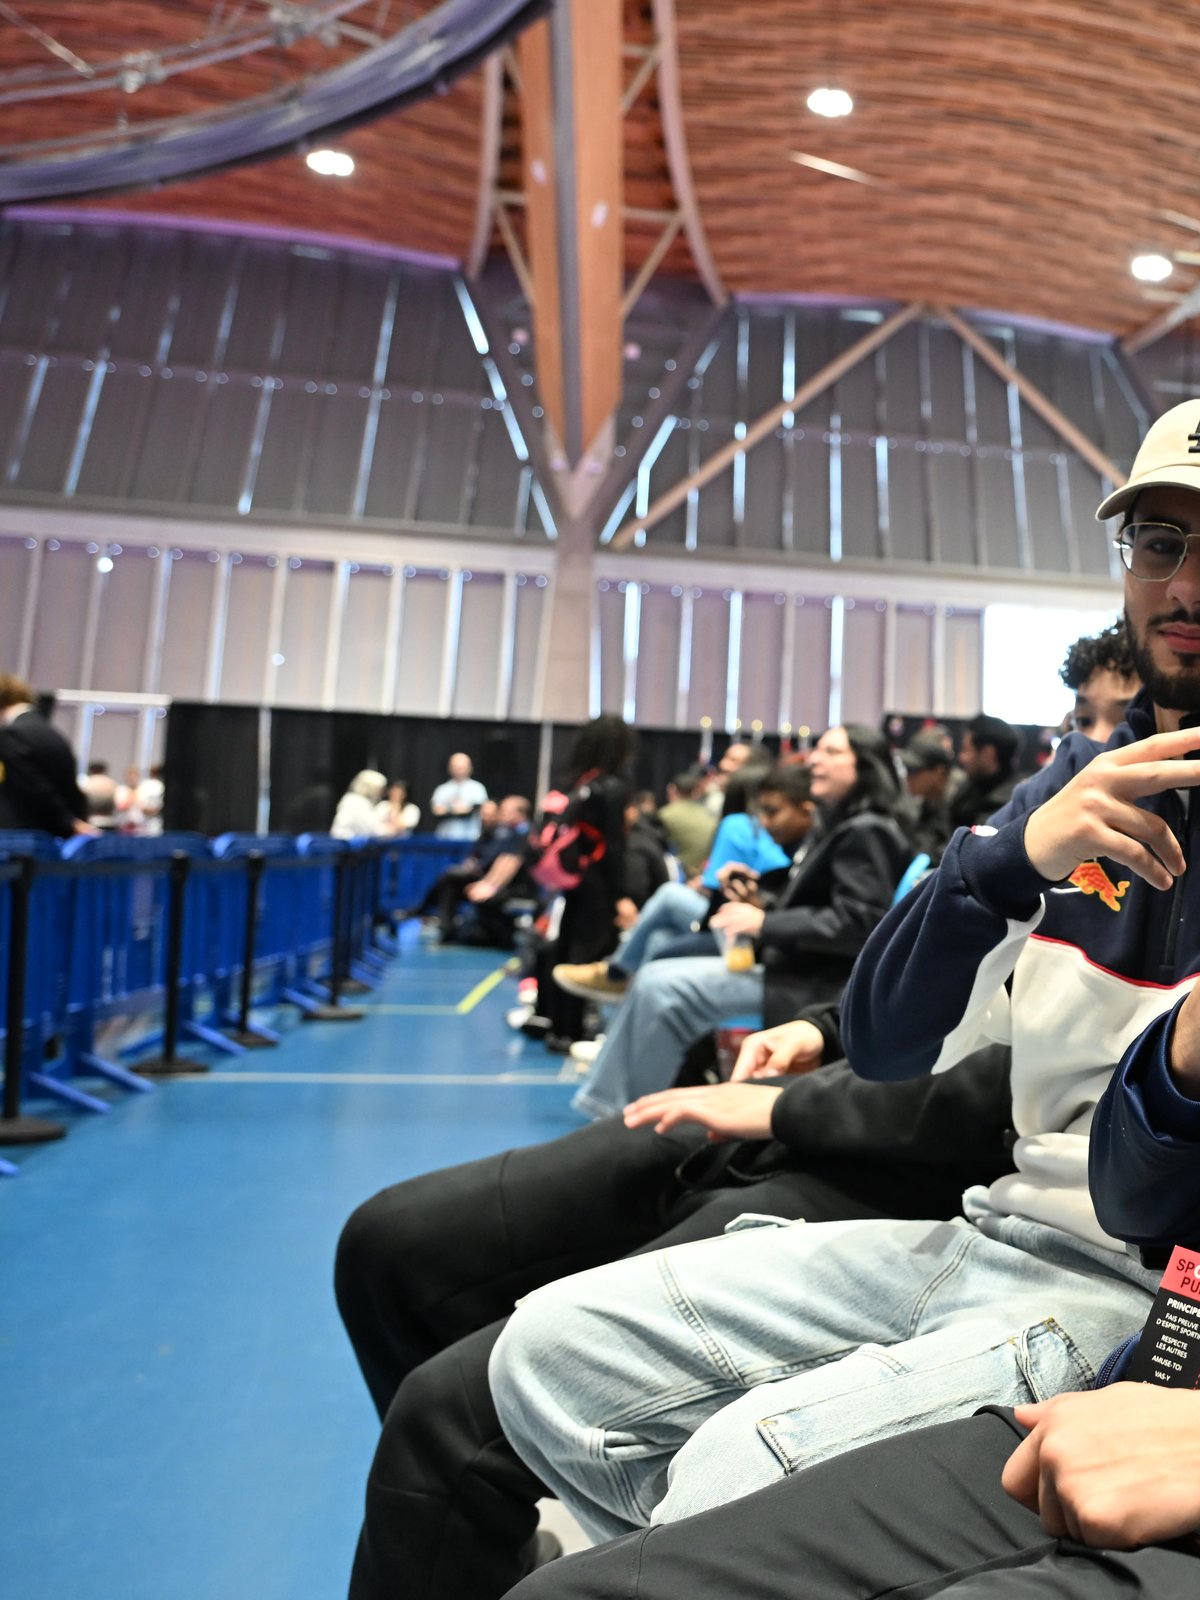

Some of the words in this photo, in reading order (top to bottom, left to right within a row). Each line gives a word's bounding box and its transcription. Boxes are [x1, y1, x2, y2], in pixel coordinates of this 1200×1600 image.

[1156, 1318, 1180, 1332] D'ESPRIT
[1165, 1312, 1178, 1323] FAIS
[1177, 1317, 1200, 1331] PREUVE
[1155, 1341, 1167, 1351] LES
[1165, 1345, 1188, 1359] AUTRES
[1161, 1334, 1189, 1350] RESPECTE
[1151, 1354, 1183, 1371] AMUSE-TOI
[1154, 1369, 1172, 1382] VAS-Y
